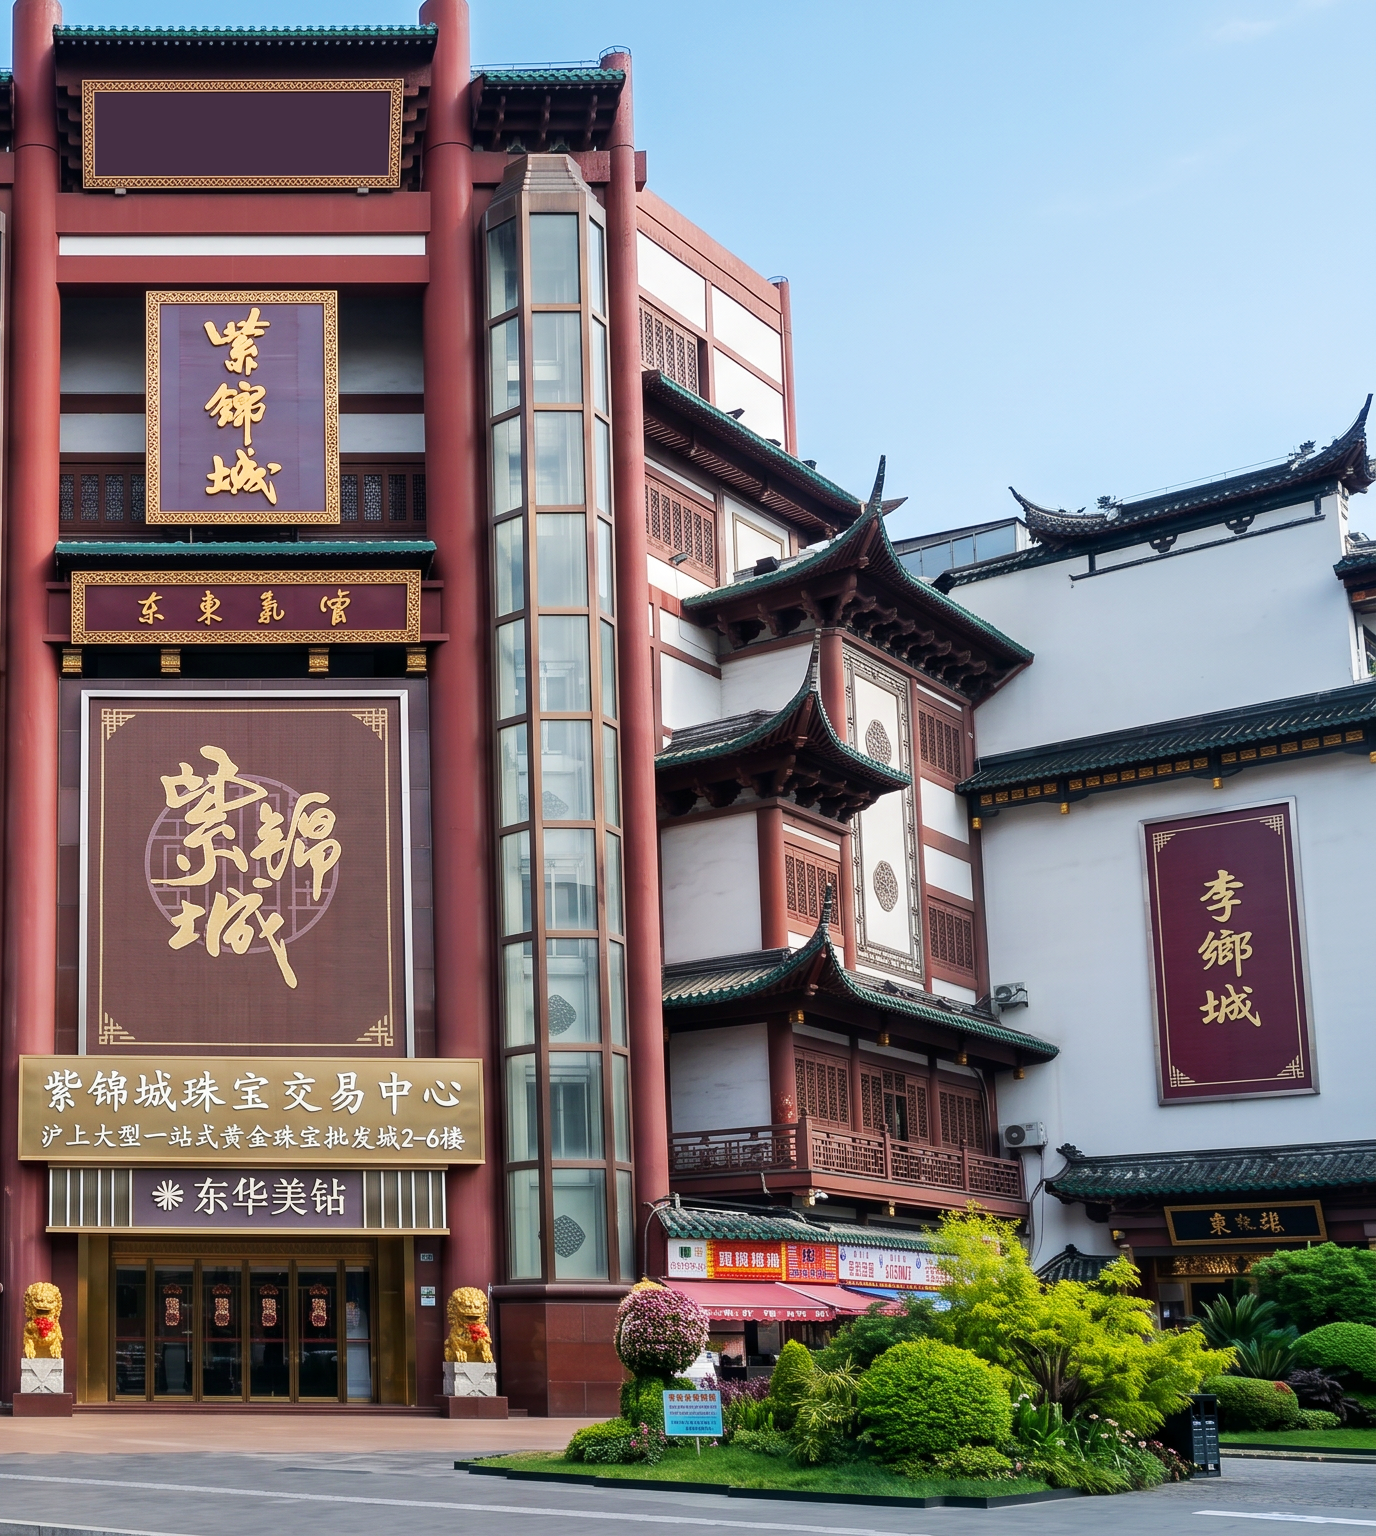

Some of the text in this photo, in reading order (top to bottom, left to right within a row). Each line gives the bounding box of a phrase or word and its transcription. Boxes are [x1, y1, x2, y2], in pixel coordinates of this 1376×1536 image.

[43, 1068, 462, 1116] 紫锦城珠宝交易中心
[41, 1123, 466, 1151] 沪上大型一站式黄金珠宝批发城2-6楼
[193, 1177, 347, 1216] 东华美钻
